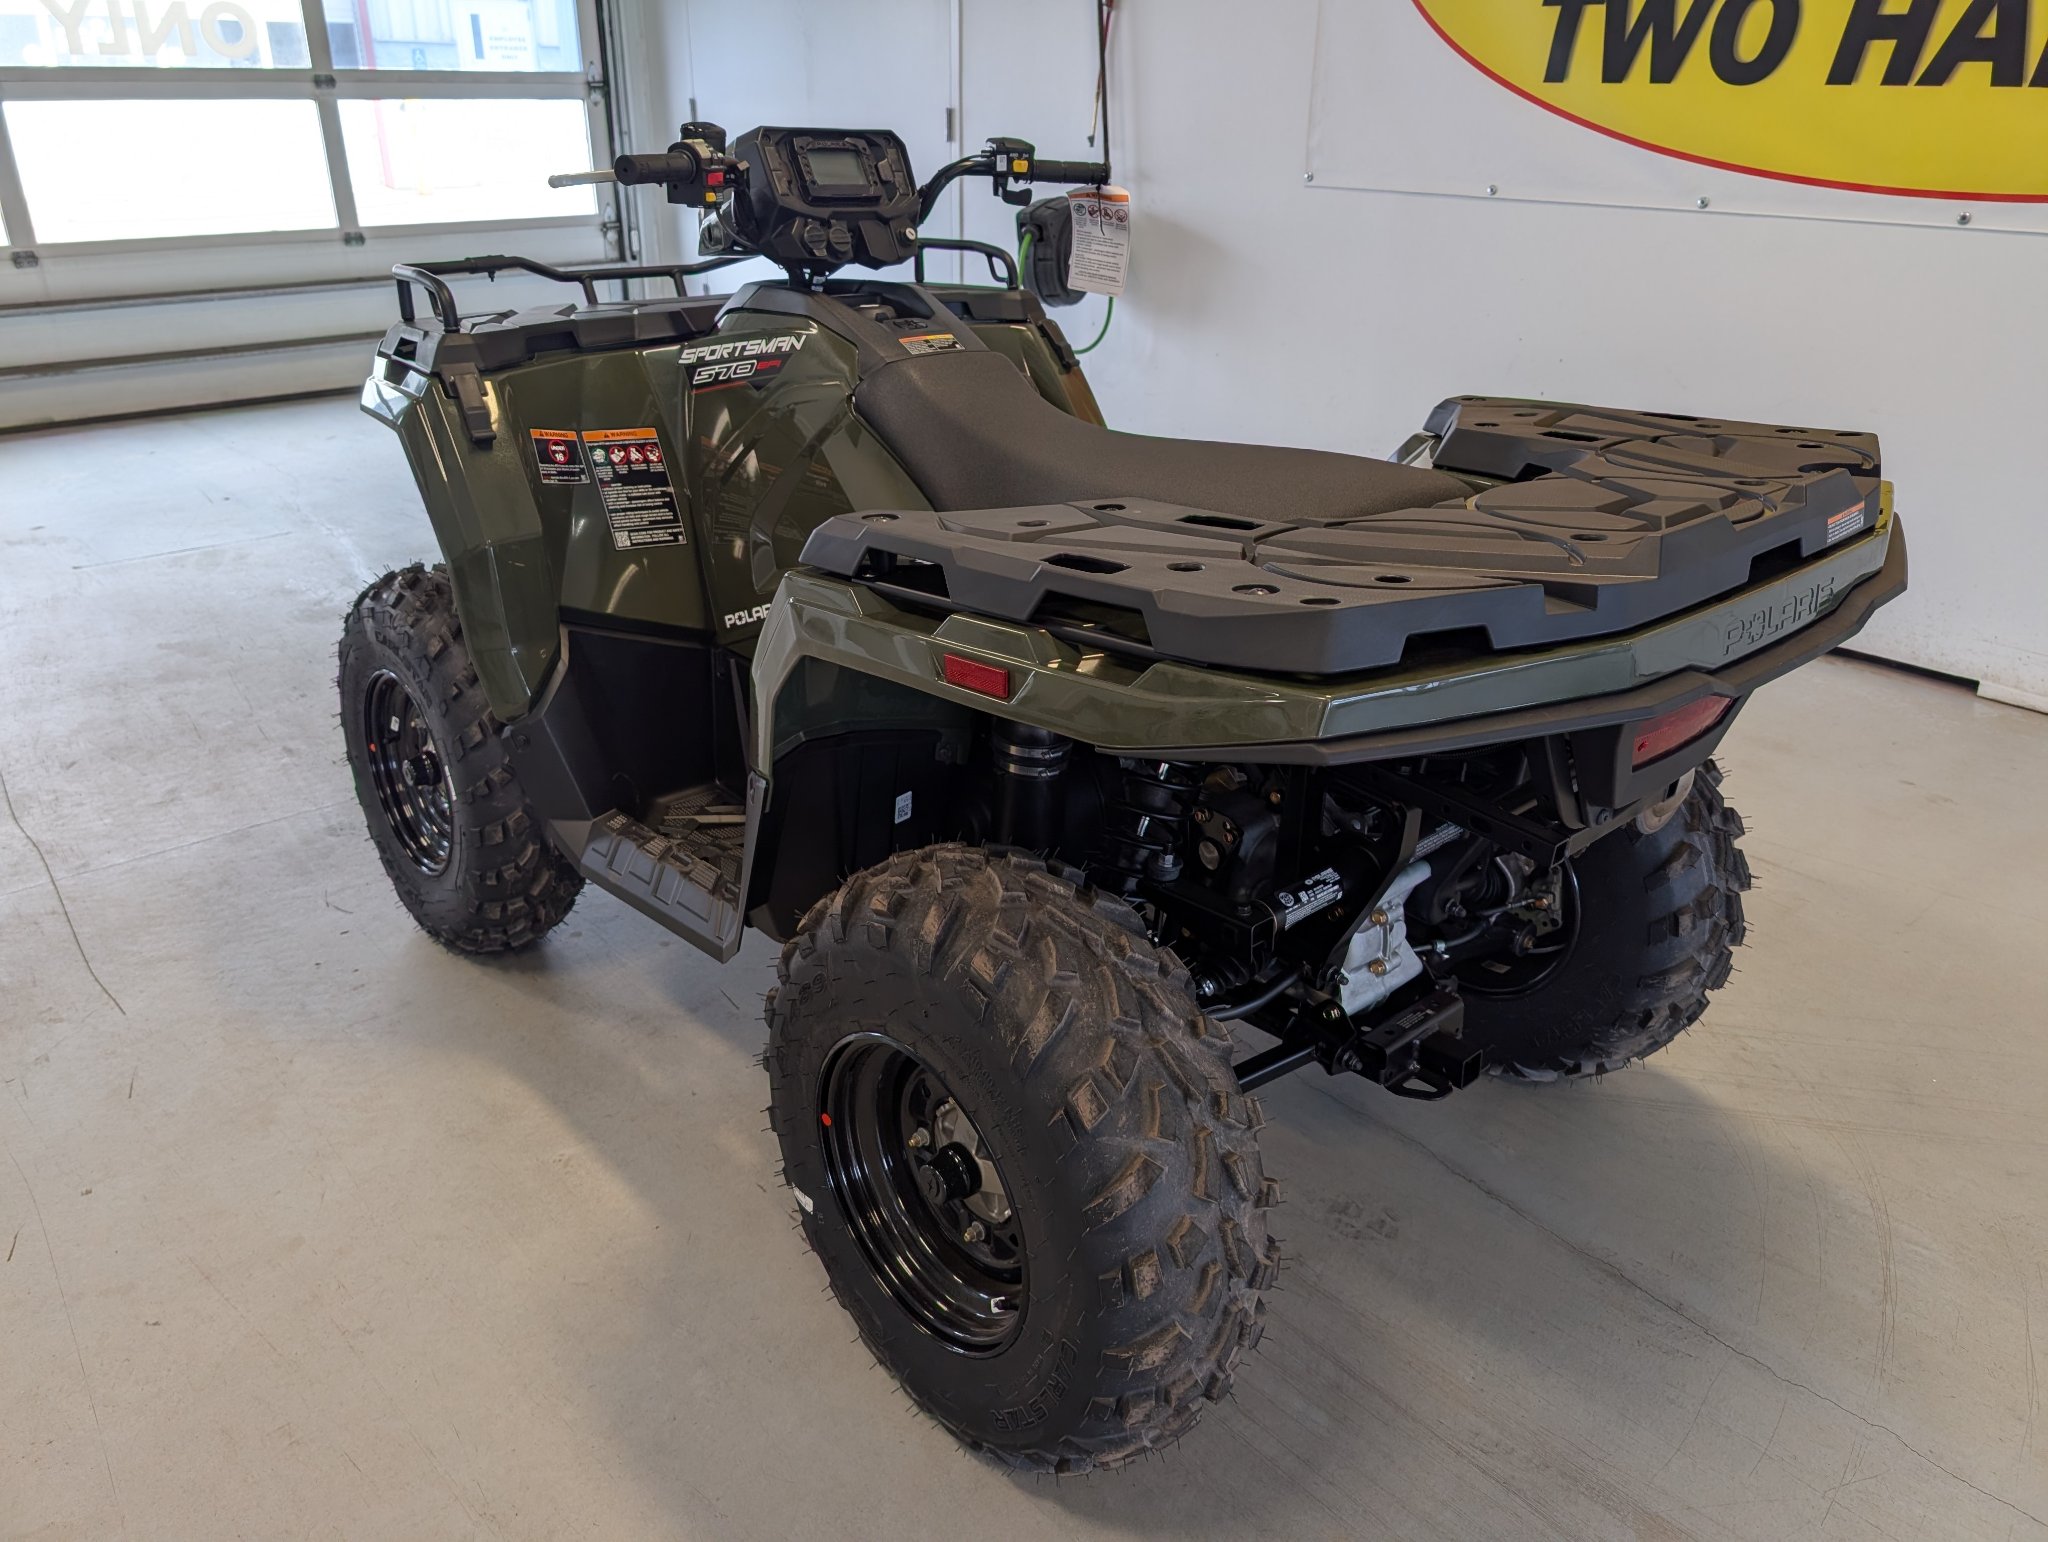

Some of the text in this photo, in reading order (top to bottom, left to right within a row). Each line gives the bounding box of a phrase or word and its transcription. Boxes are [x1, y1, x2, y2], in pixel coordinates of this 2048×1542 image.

[1541, 0, 2048, 88] TWO HA
[678, 335, 807, 364] SPORTSMAN
[693, 360, 757, 384] 570
[555, 453, 565, 461] 16
[1723, 576, 1836, 657] POLARIS
